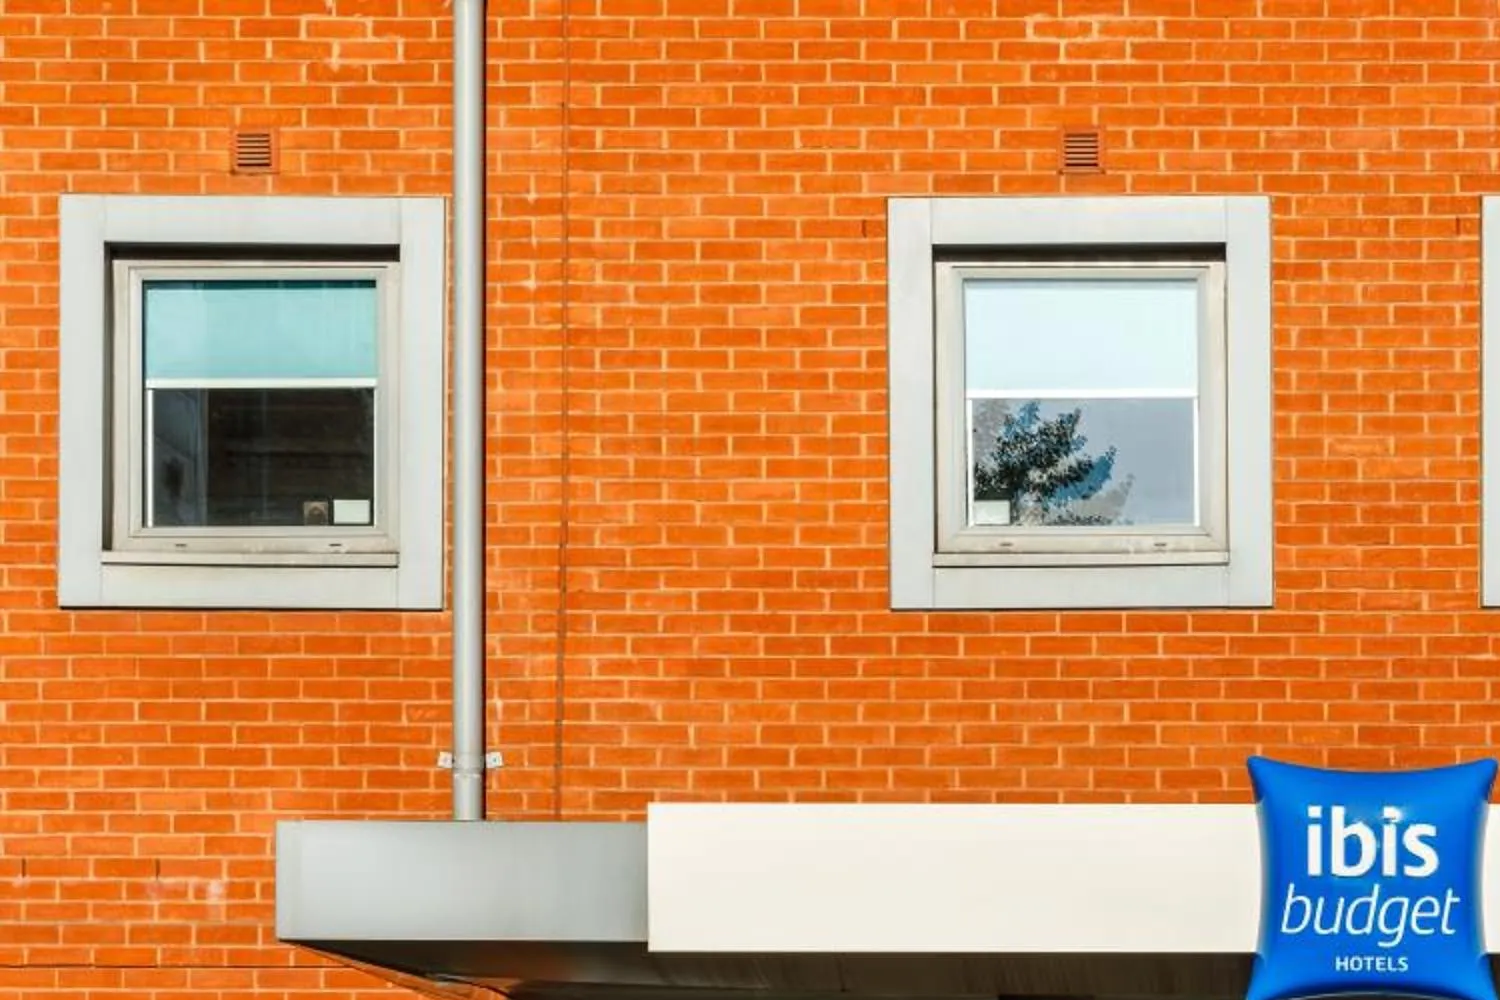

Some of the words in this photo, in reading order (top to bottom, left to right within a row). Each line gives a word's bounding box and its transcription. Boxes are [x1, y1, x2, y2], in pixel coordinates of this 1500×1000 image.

[1307, 805, 1440, 877] ibis
[1281, 883, 1460, 948] budget
[1335, 956, 1409, 972] HOTELS
